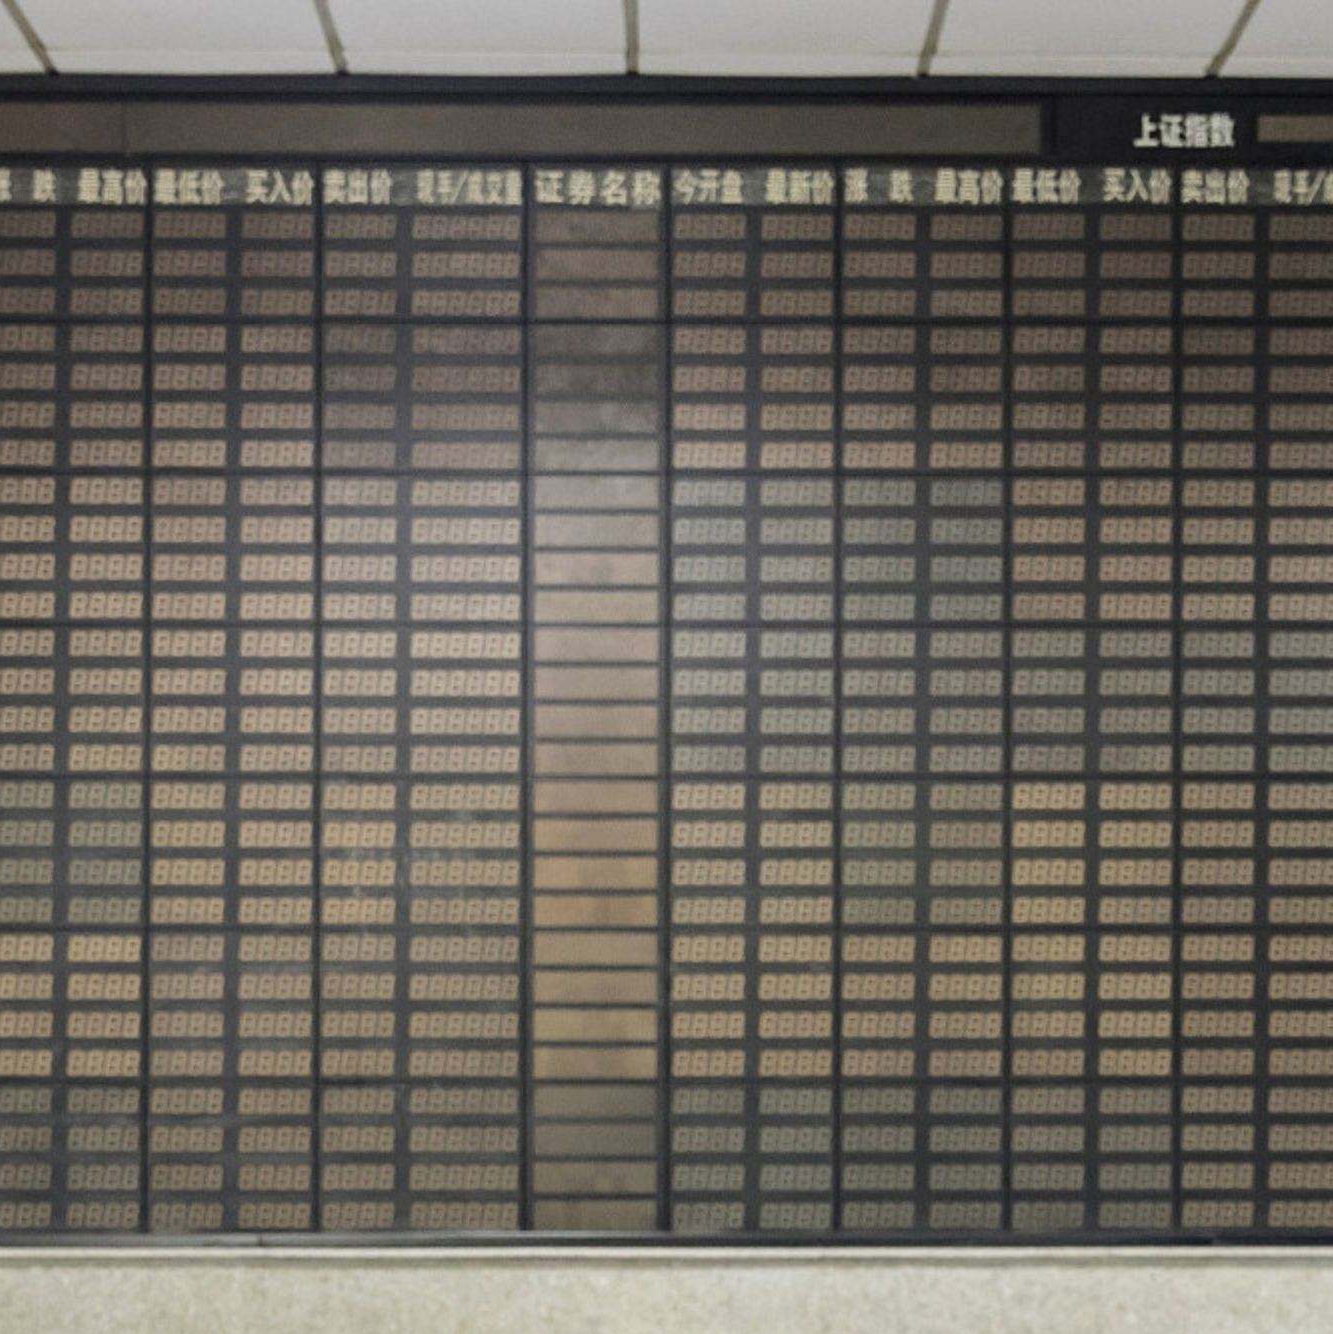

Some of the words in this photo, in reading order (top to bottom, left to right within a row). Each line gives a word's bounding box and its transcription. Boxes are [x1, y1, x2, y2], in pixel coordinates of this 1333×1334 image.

[1133, 113, 1235, 148] 上证指数
[77, 167, 148, 206] 最高价
[153, 168, 226, 205] 最低价
[244, 168, 315, 206] 买入价
[323, 168, 394, 205] 卖出价
[534, 169, 662, 207] 证券名称
[673, 168, 745, 205] 今开盘
[763, 168, 835, 205] 最新价
[933, 168, 1004, 206] 最高价
[1011, 168, 1081, 204] 最低价
[1103, 167, 1172, 204] 买入价
[1181, 169, 1250, 205] 卖出价
